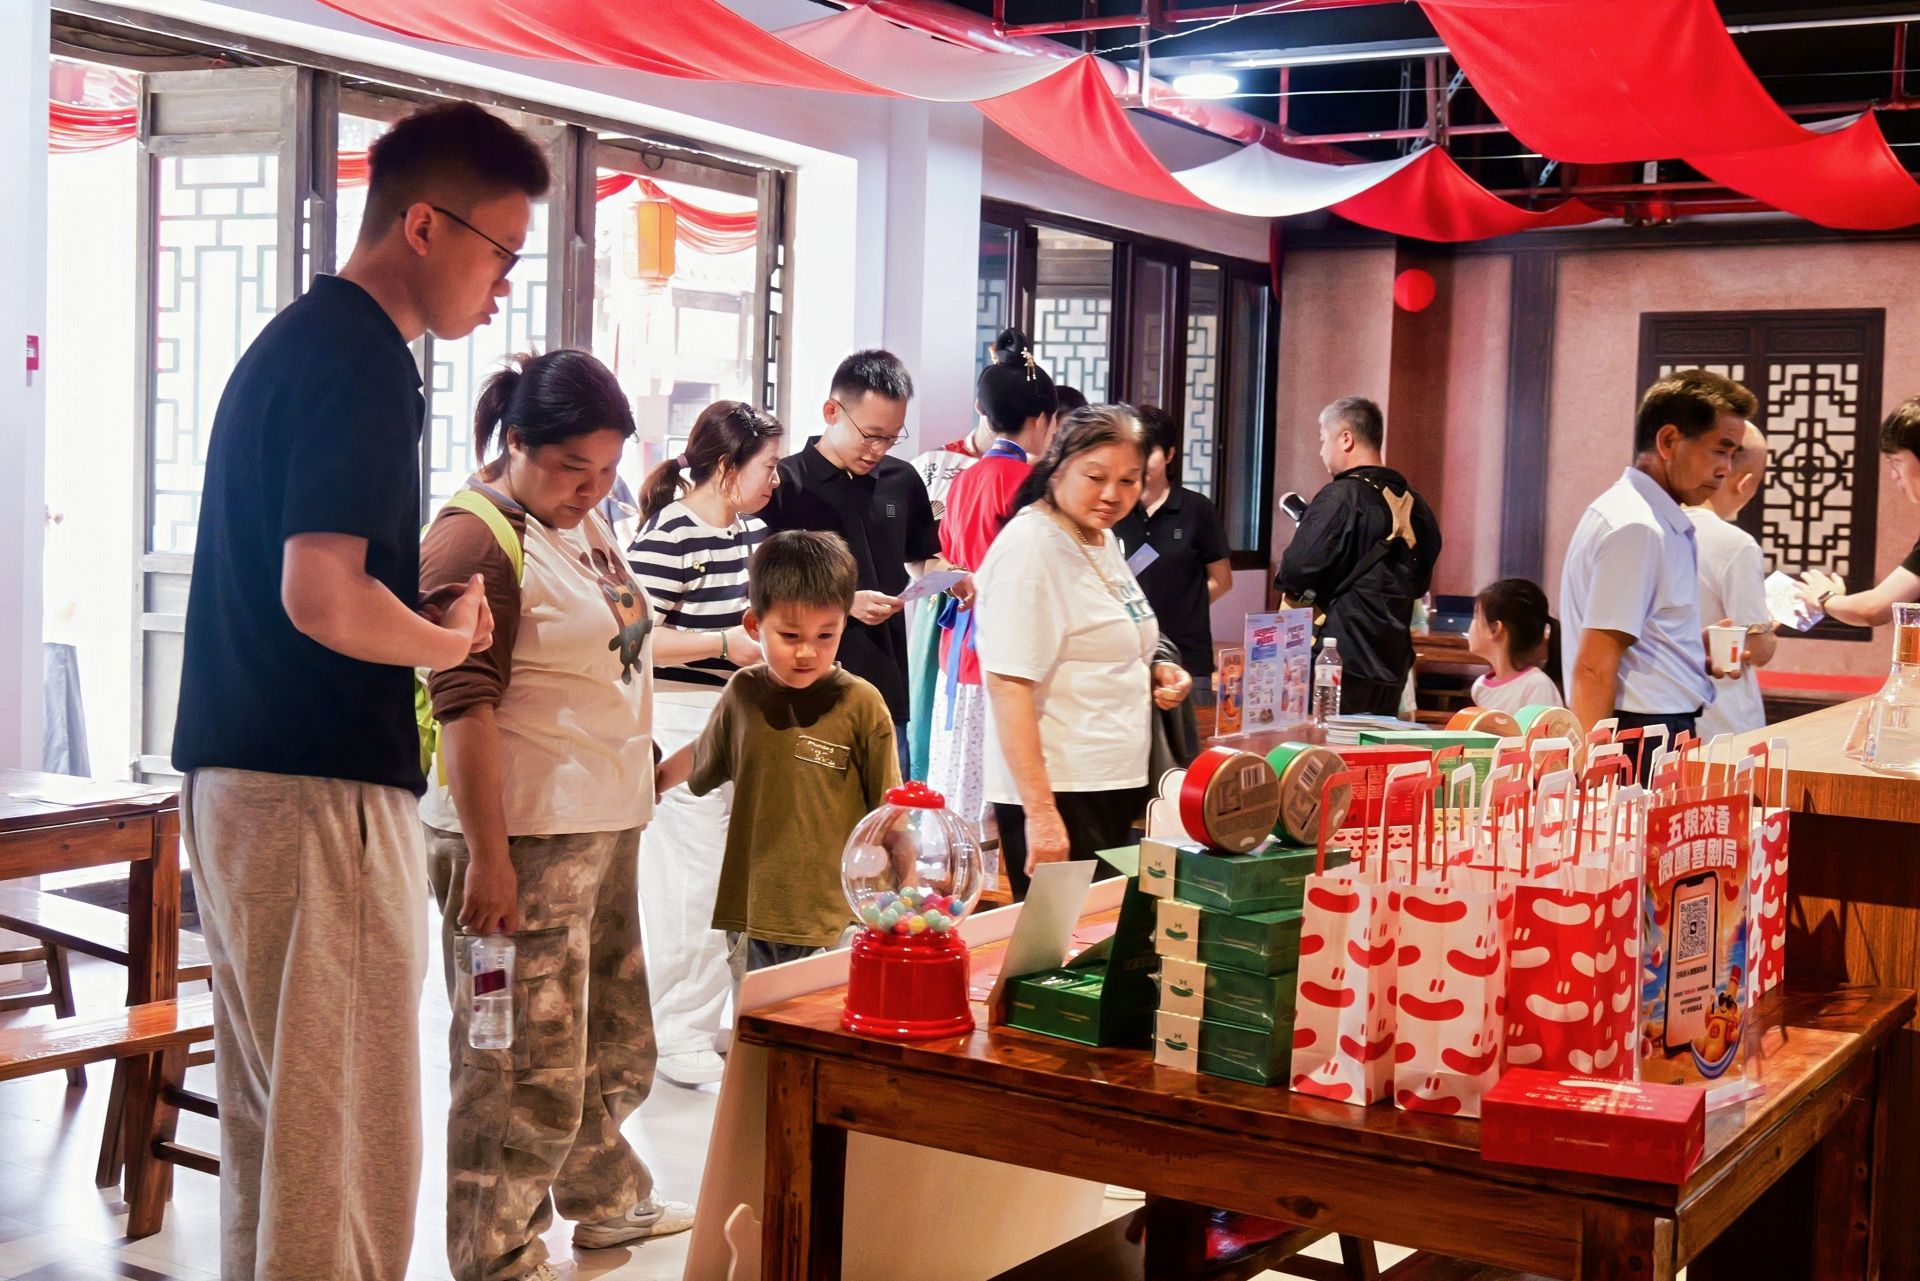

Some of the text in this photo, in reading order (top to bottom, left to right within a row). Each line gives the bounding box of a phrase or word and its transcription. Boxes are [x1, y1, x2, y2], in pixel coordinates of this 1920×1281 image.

[1668, 805, 1729, 847] 五粮浓香
[1659, 838, 1736, 886] 微醺喜剧局
